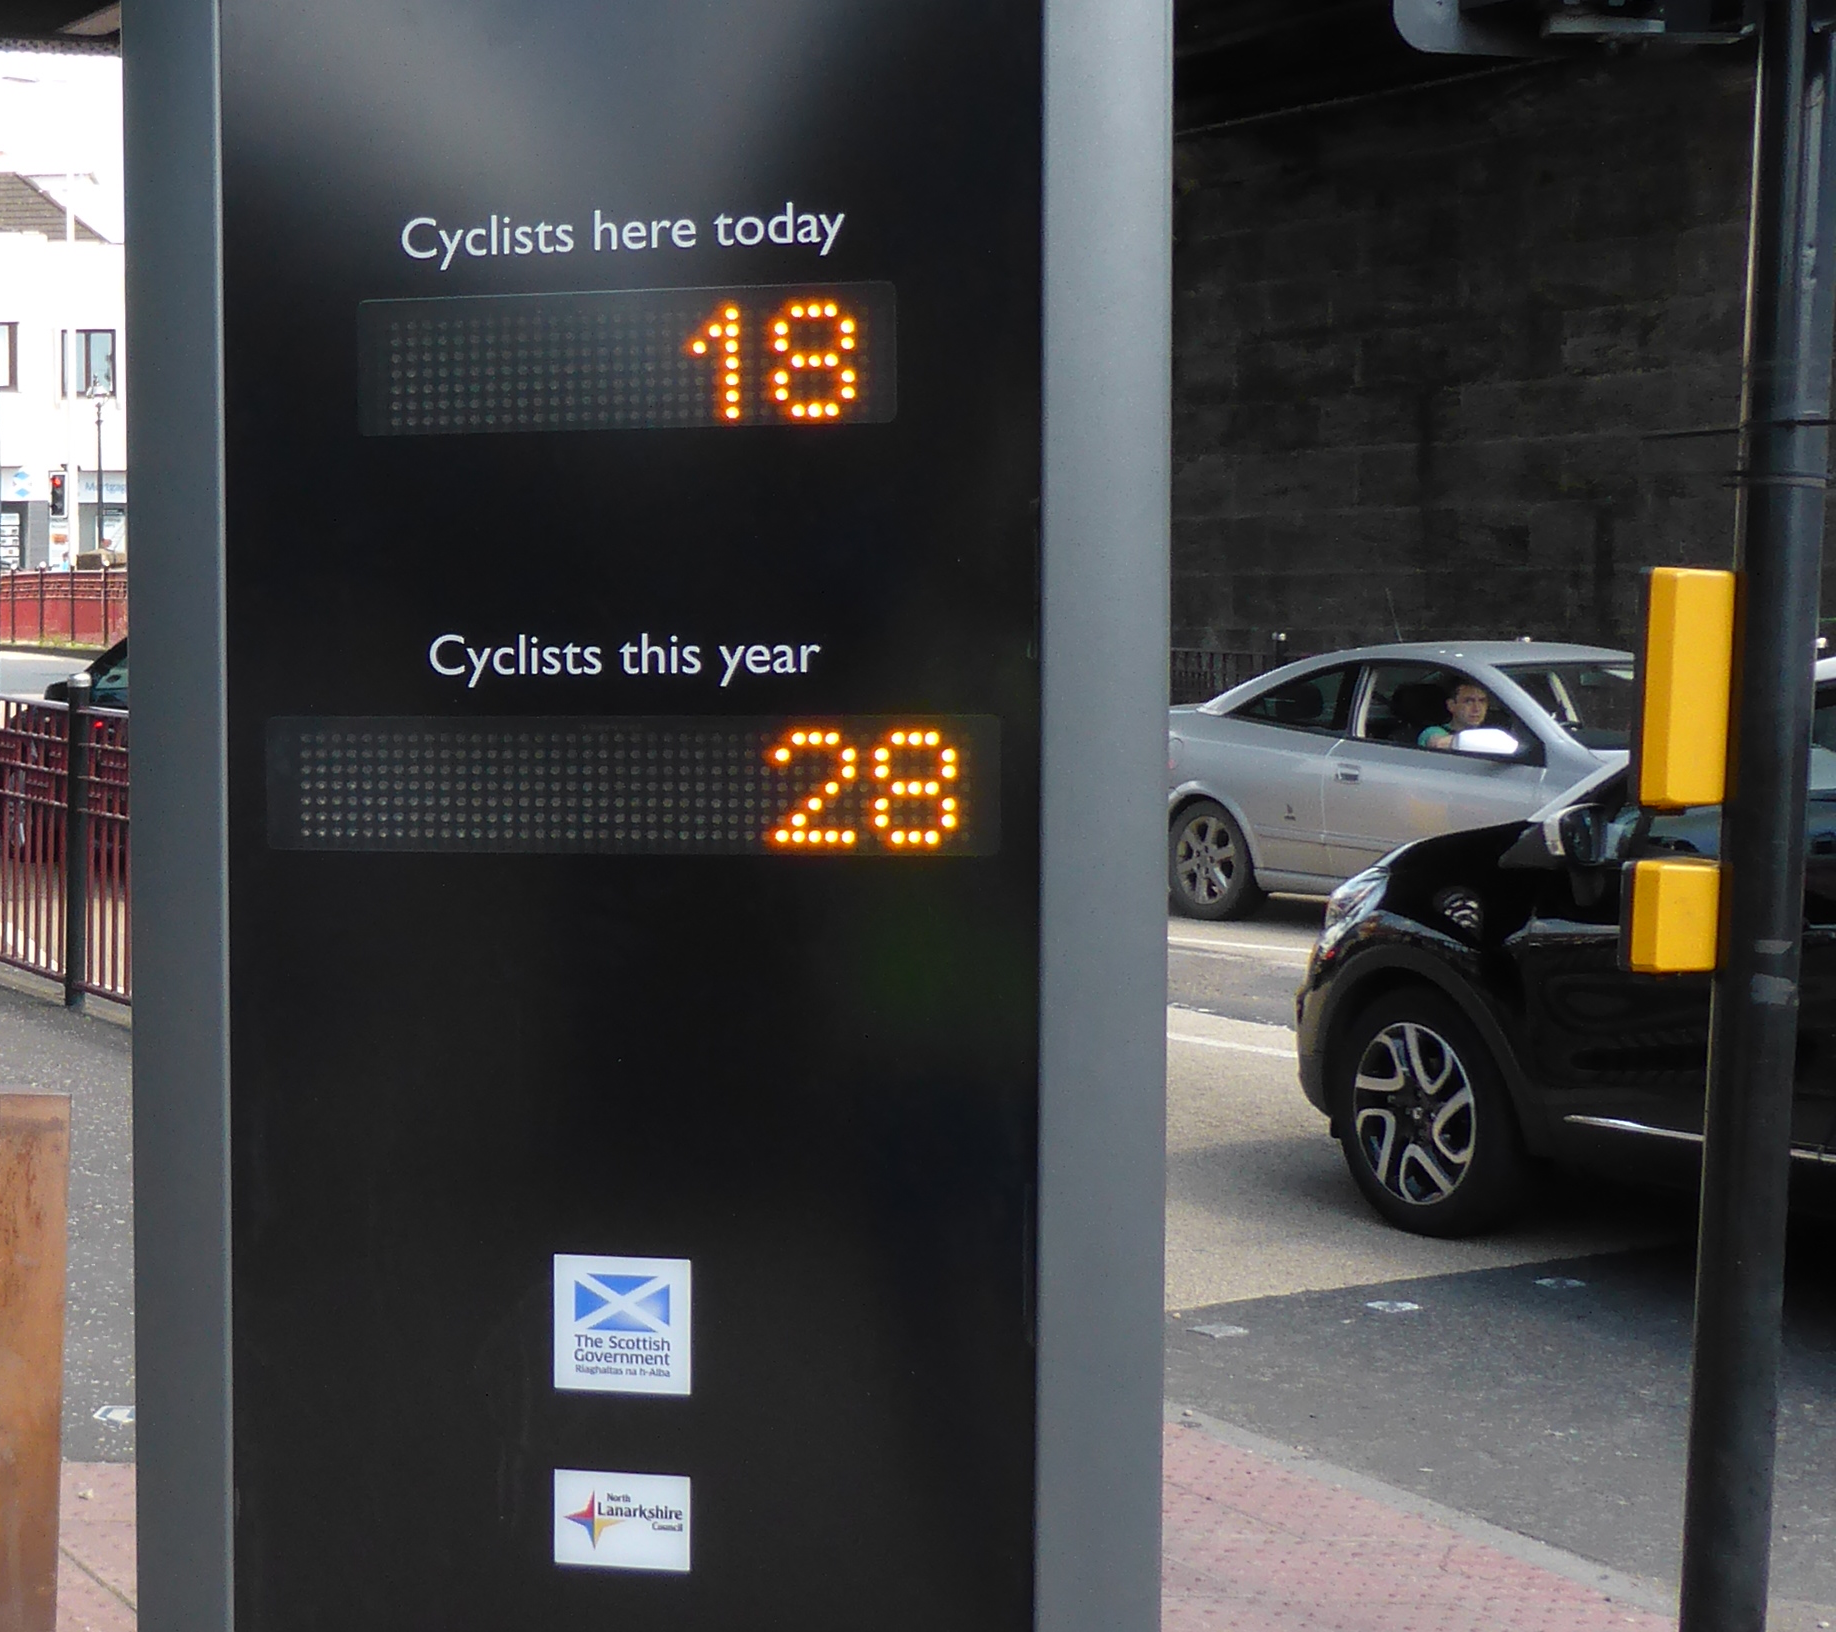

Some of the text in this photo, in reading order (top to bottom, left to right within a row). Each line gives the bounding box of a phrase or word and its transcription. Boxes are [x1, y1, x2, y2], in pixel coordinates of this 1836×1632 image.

[400, 201, 846, 271] Cyclists here today
[684, 300, 858, 421] 18
[429, 632, 821, 688] Cyclists this year
[766, 729, 959, 849] 28
[574, 1334, 671, 1352] The Scottish
[574, 1348, 671, 1366] Government
[597, 1501, 684, 1521] Lanarkshire
[606, 1493, 632, 1503] North
